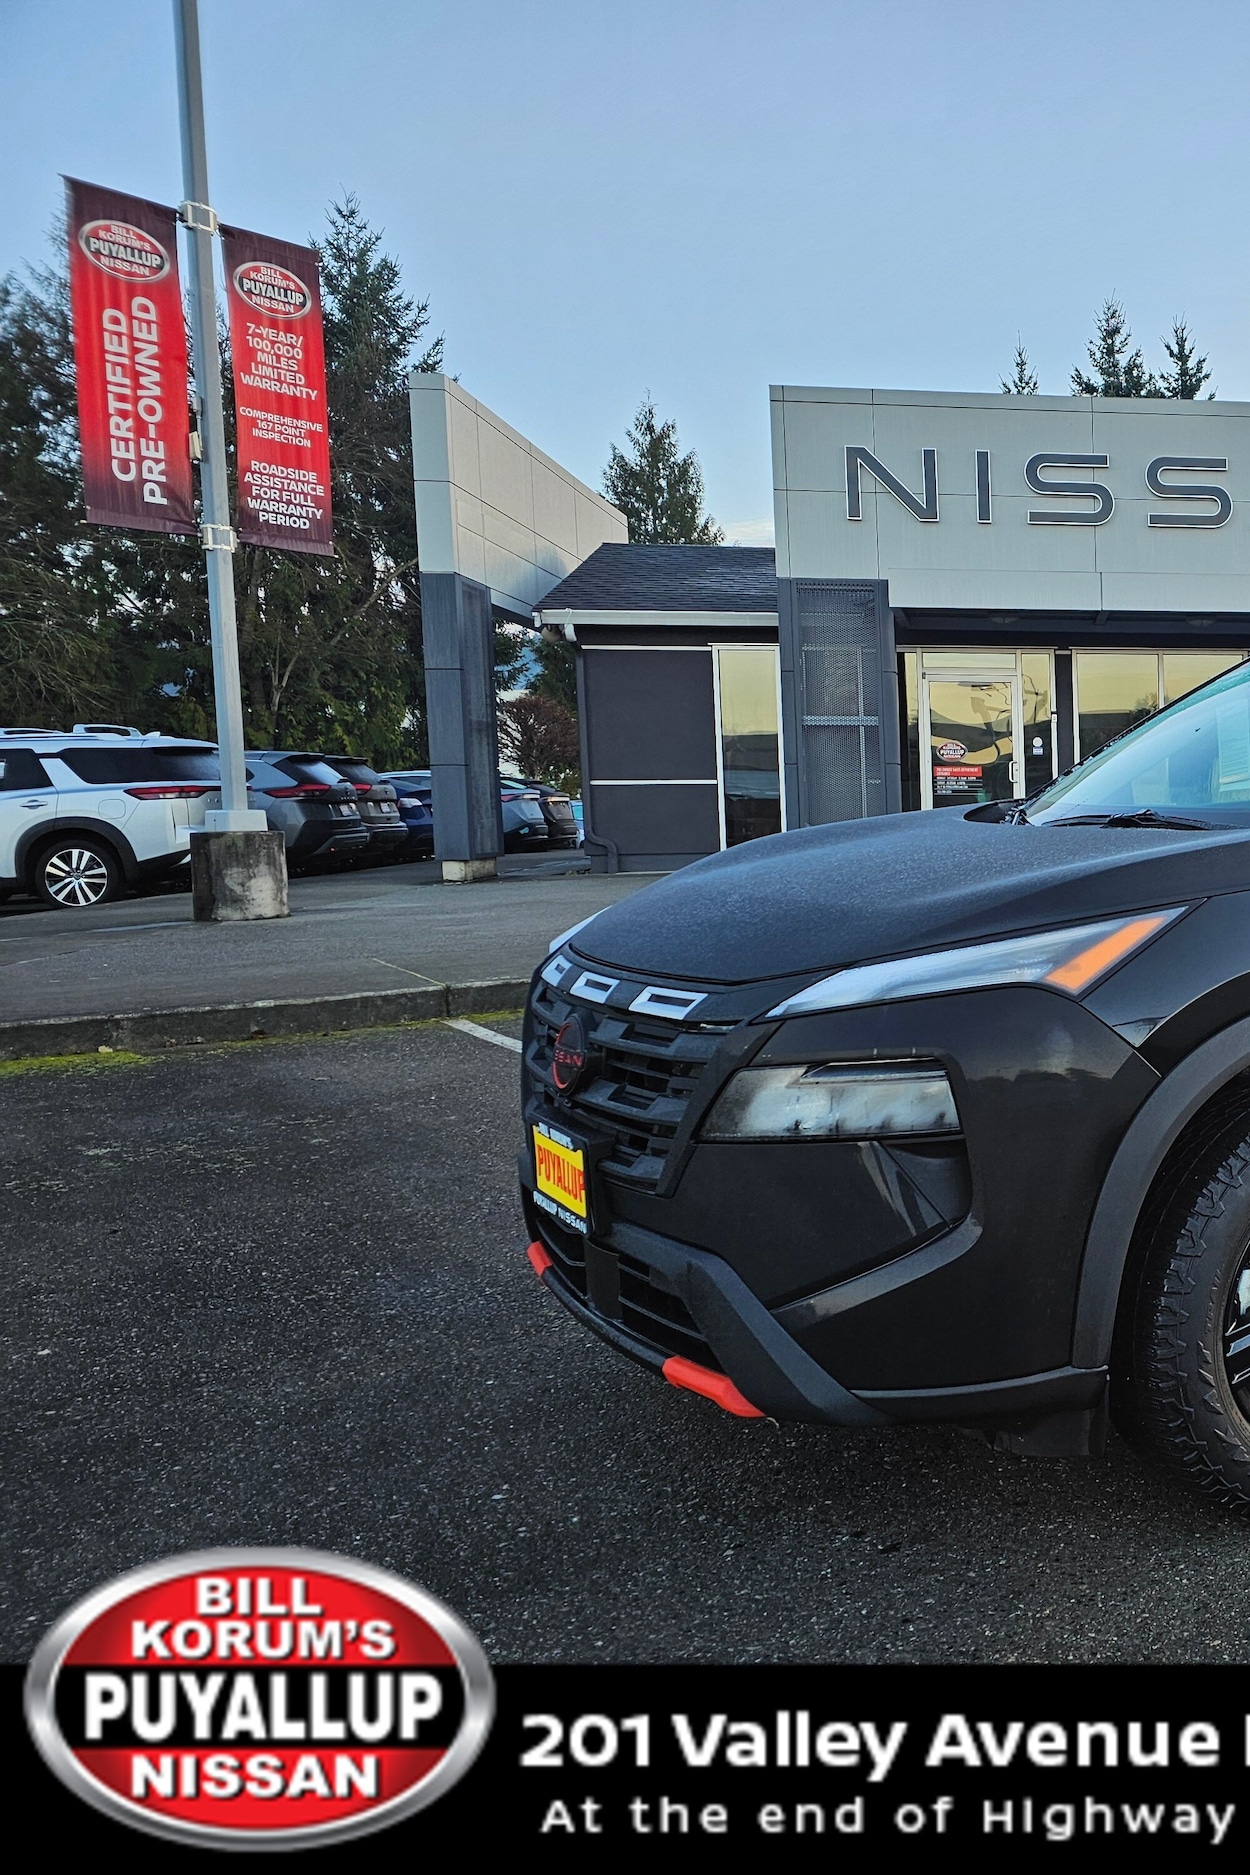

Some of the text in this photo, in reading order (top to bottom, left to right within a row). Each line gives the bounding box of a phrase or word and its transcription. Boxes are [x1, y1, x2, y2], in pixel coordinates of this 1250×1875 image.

[98, 229, 151, 251] KORUM'S
[110, 224, 137, 239] BILL
[89, 237, 161, 268] PUYALLUP
[100, 255, 150, 276] NISSAN
[260, 266, 283, 280] BILL
[242, 278, 304, 305] PUYALLUP
[249, 271, 296, 290] KORUM'S
[251, 294, 295, 313] NISSAN
[246, 322, 304, 348] 7-YEAR/
[246, 335, 303, 360] 100,000
[257, 351, 298, 371] MILES
[251, 362, 305, 385] LIMITED
[102, 308, 137, 482] CERTIFIED
[240, 372, 318, 400] WARRANTY
[131, 296, 168, 505] PRE-OWNED
[239, 406, 323, 432] COMPREHENSIVE
[256, 420, 306, 437] 167 POINT
[252, 428, 311, 448] INSPECTION
[250, 460, 317, 483] ROADSIDE
[243, 472, 325, 496] ASSISTANCE
[247, 497, 323, 519] WARRANTY
[251, 486, 315, 507] FOR FULL
[258, 511, 310, 529] PERIOD
[536, 1144, 585, 1203] PUYALLUP
[558, 1207, 588, 1235] NISSAN
